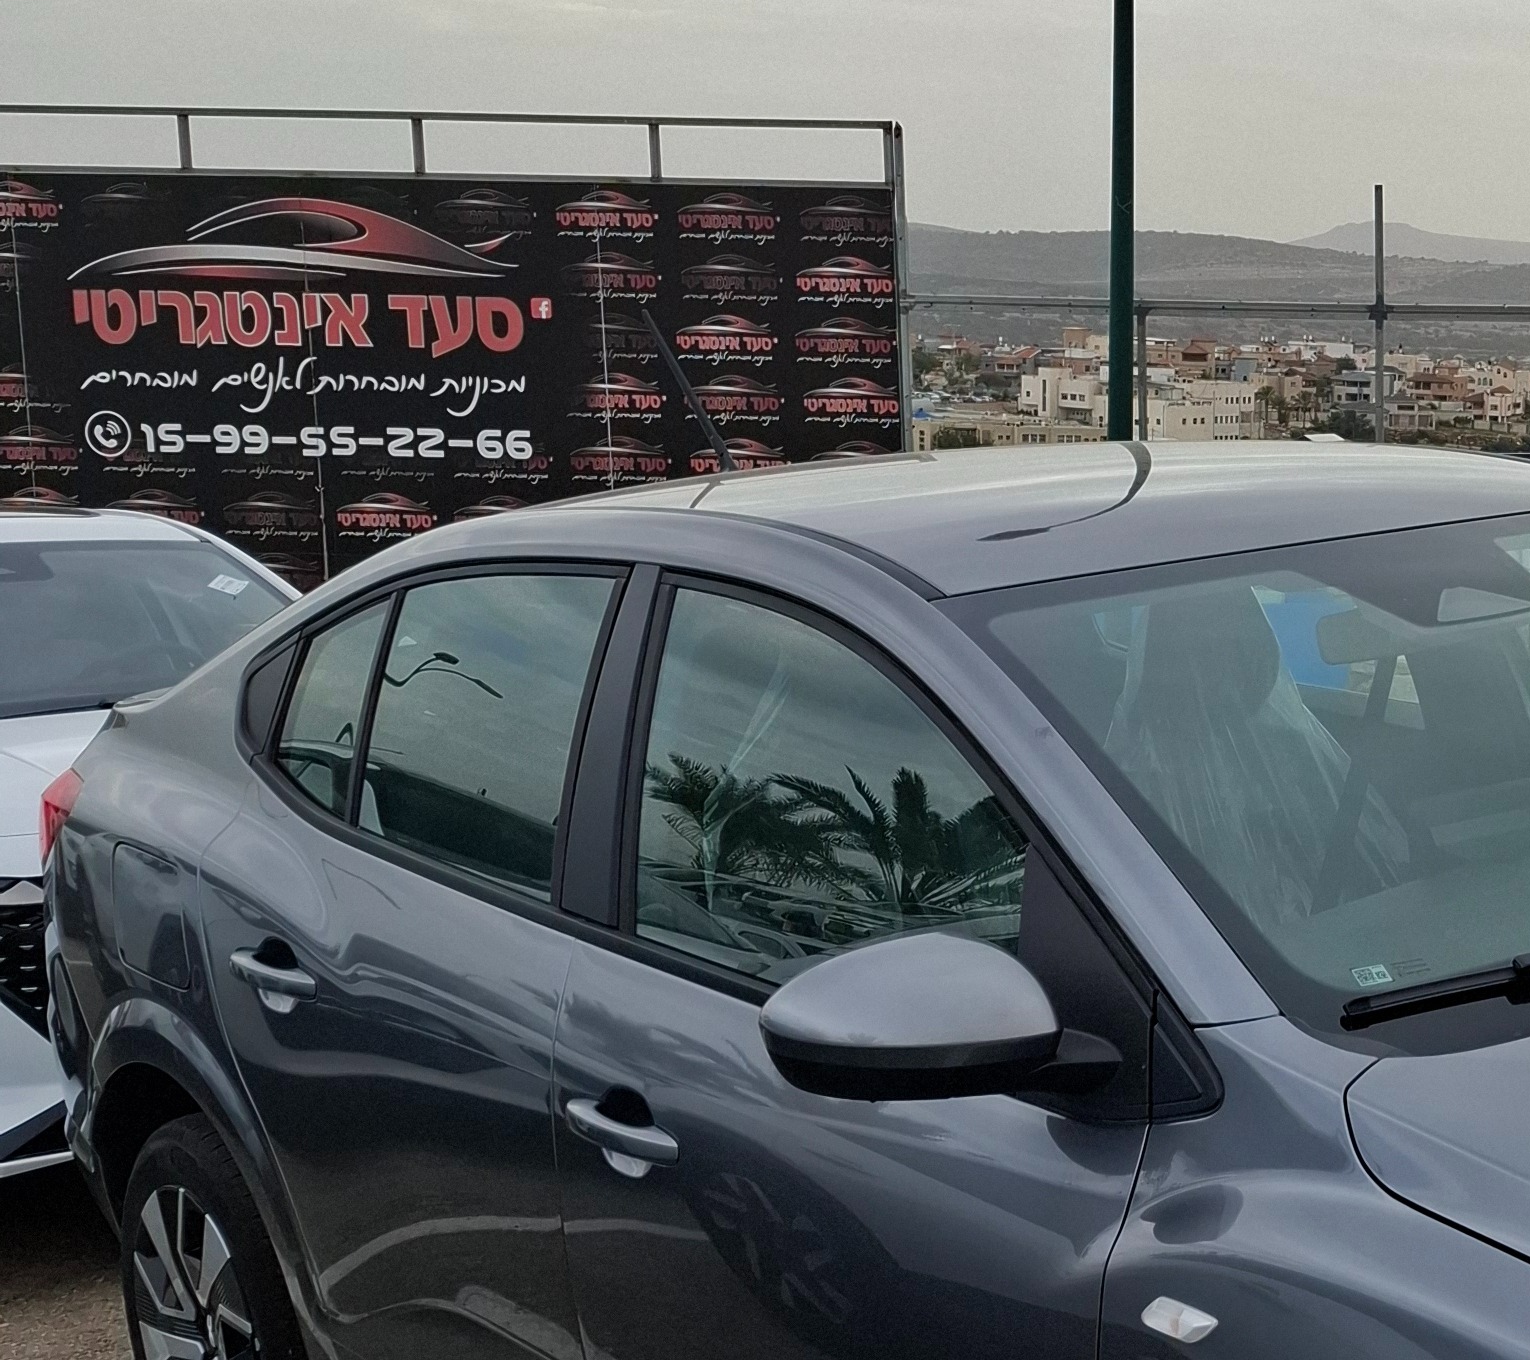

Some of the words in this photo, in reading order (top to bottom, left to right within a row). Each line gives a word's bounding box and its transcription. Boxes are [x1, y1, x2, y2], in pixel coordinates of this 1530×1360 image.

[864, 277, 893, 293] סעד
[72, 288, 374, 349] אינטגריטי
[388, 294, 524, 358] סעד
[743, 336, 773, 352] סעד
[80, 368, 198, 390] מובחרים
[211, 356, 318, 413] לאנשים
[306, 372, 424, 395] מובחרות
[430, 375, 526, 417] מכוניות
[140, 423, 533, 460] 15-99-55-22-66
